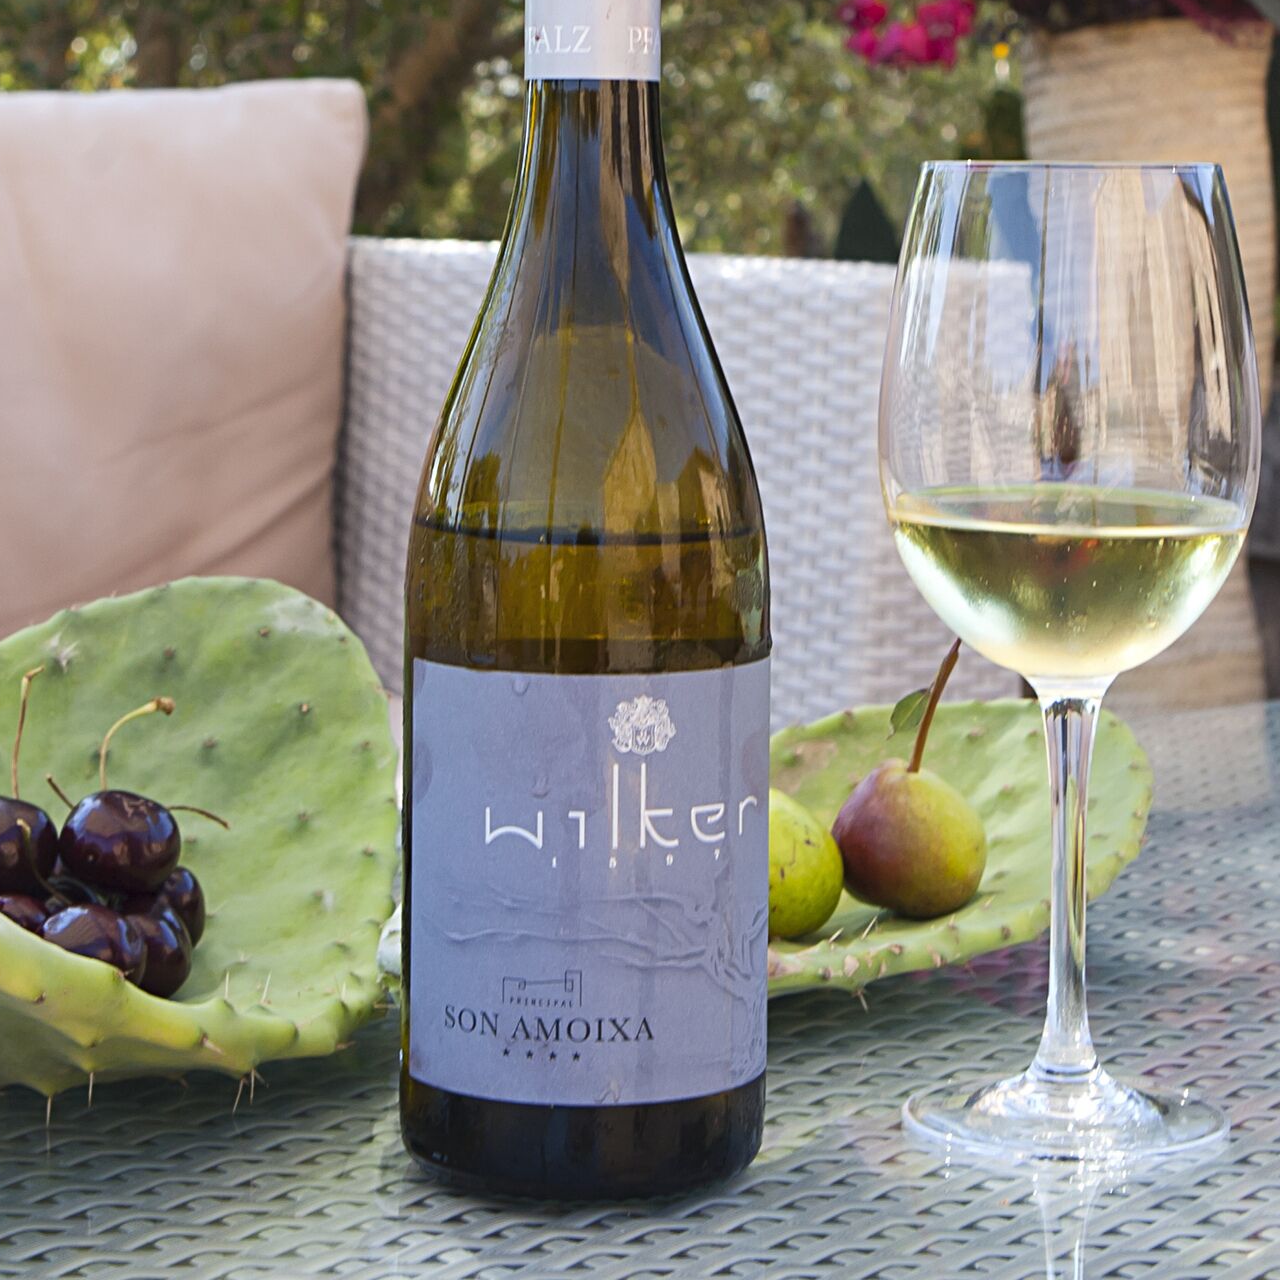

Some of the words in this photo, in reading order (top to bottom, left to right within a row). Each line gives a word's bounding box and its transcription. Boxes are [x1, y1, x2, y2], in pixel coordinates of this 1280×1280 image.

[527, 24, 592, 55] FALZ
[484, 762, 758, 850] wilker
[444, 1004, 499, 1038] SON
[511, 1016, 655, 1043] AMOIXA
